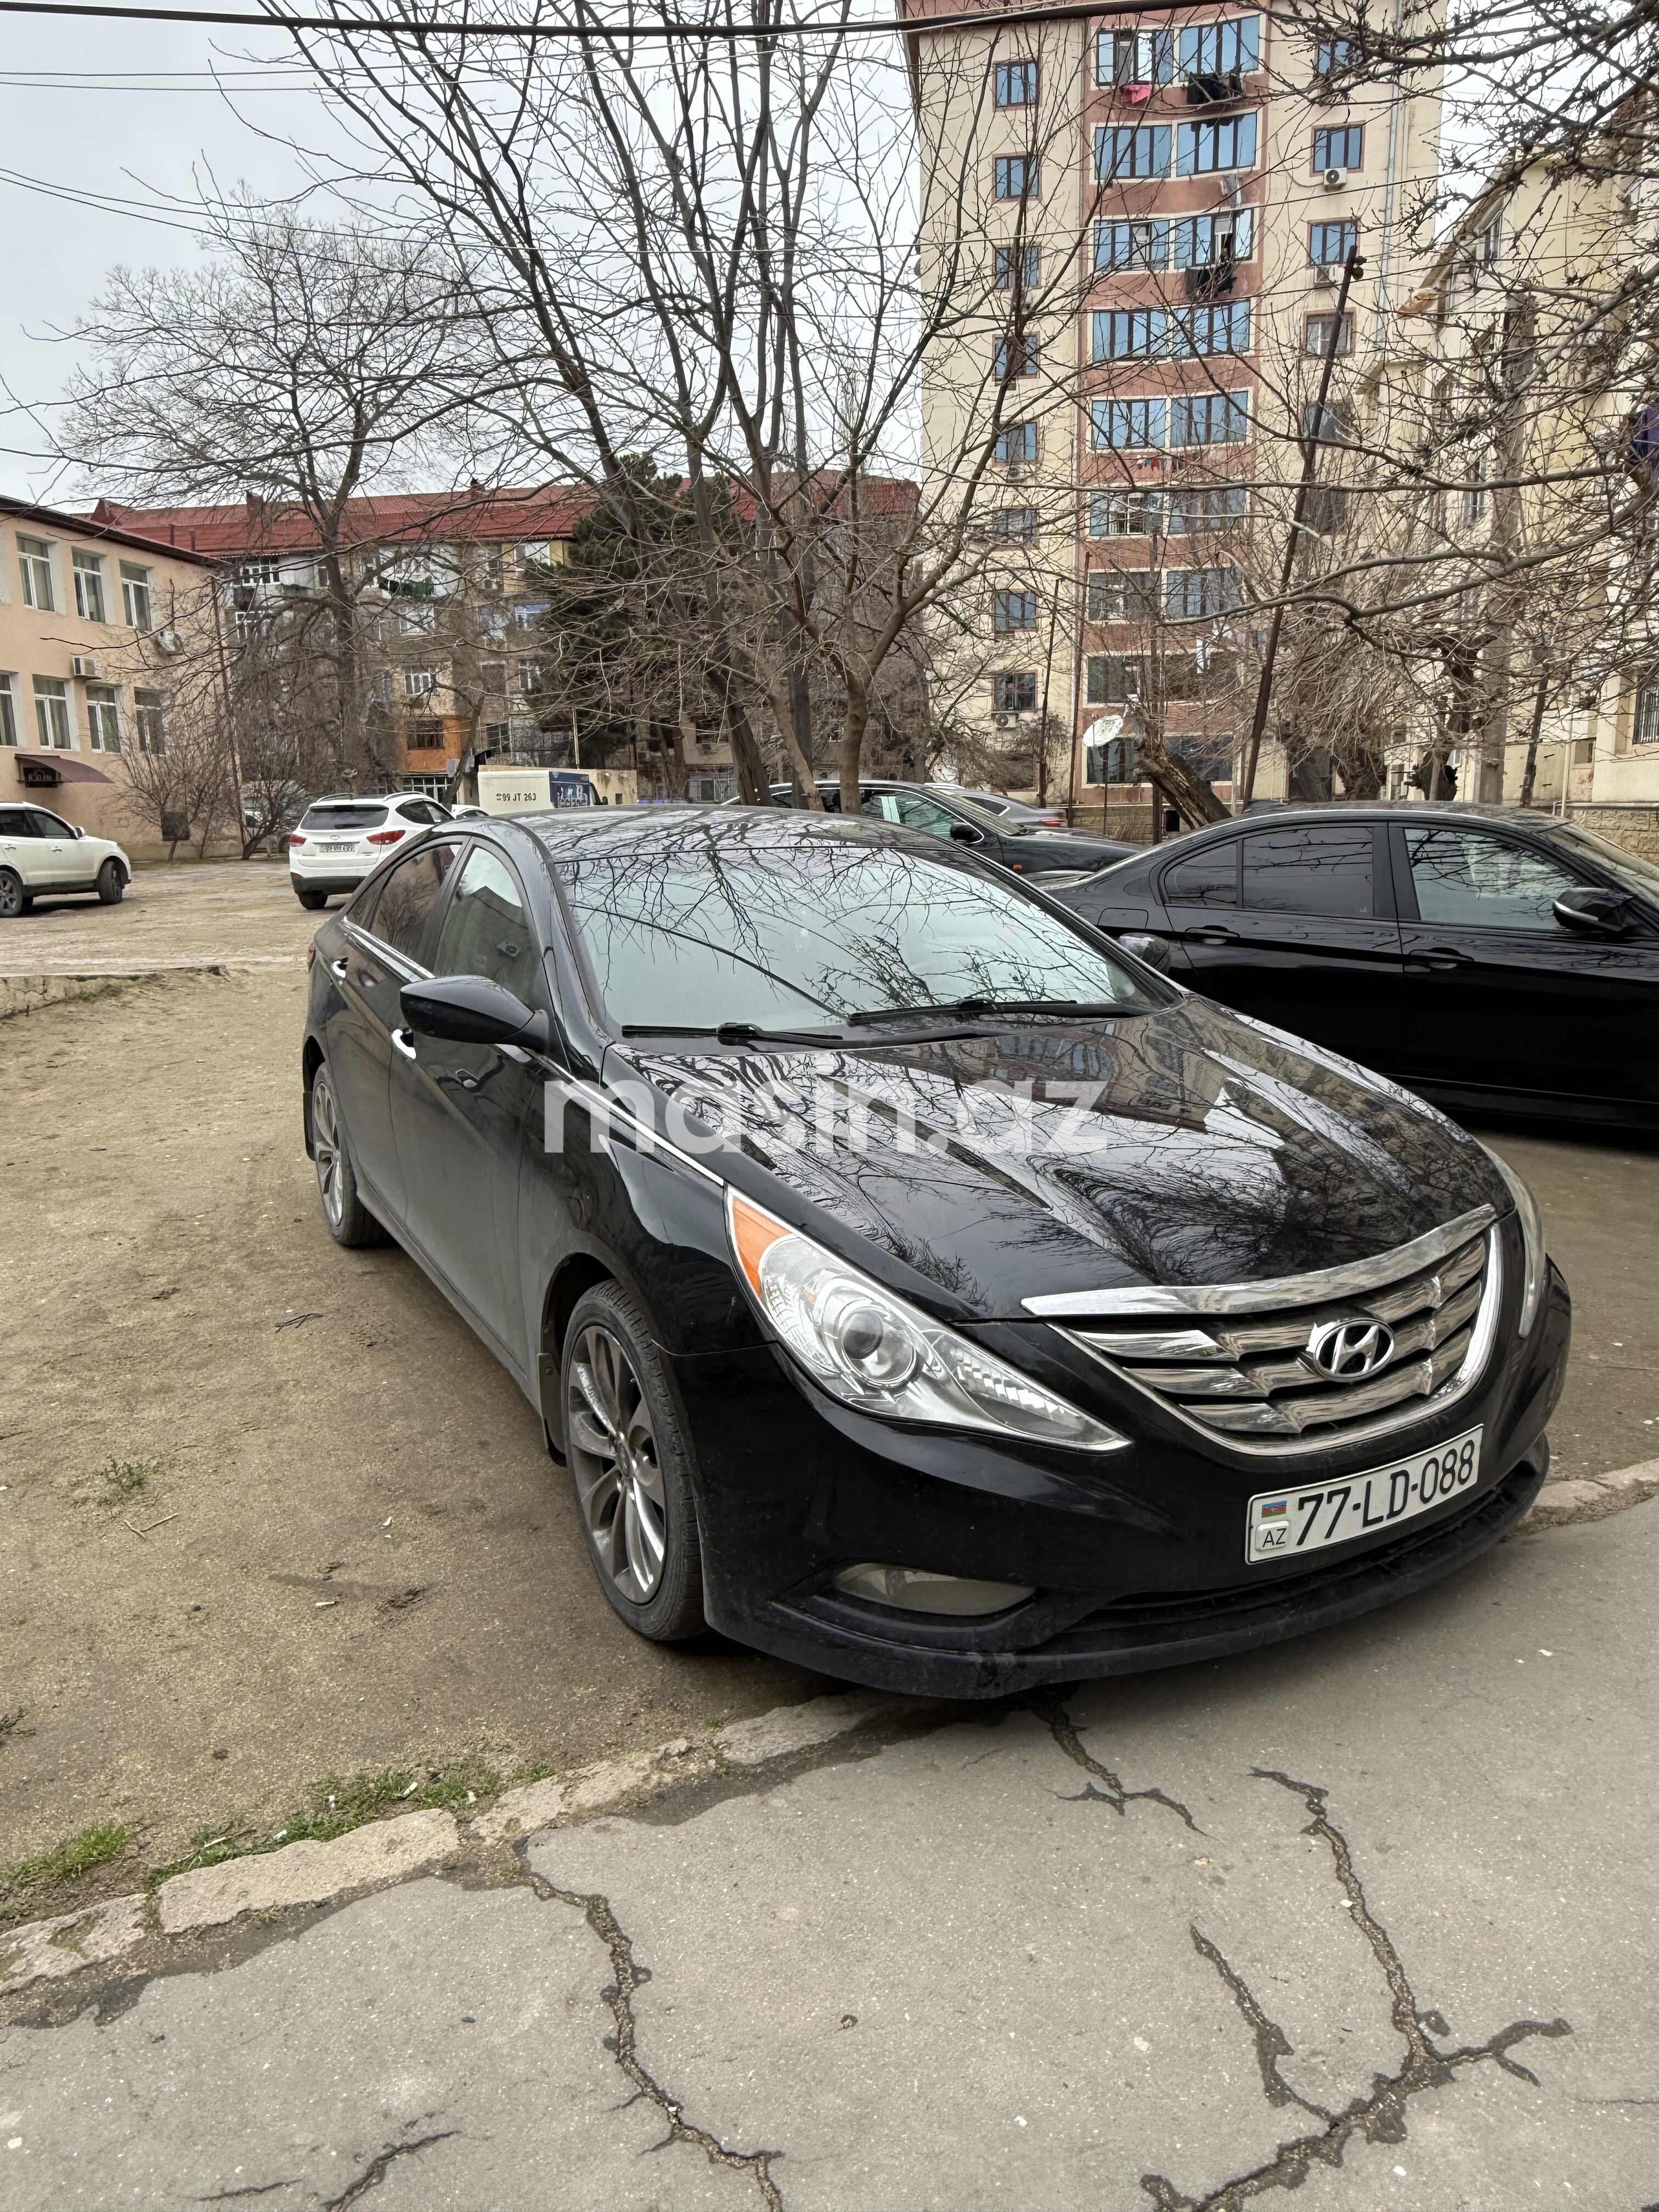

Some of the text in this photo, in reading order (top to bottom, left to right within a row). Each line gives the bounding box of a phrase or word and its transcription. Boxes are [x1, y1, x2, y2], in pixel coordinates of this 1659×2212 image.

[513, 793, 521, 802] JT
[1262, 1440, 1475, 1548] AZ 77-LD-088
